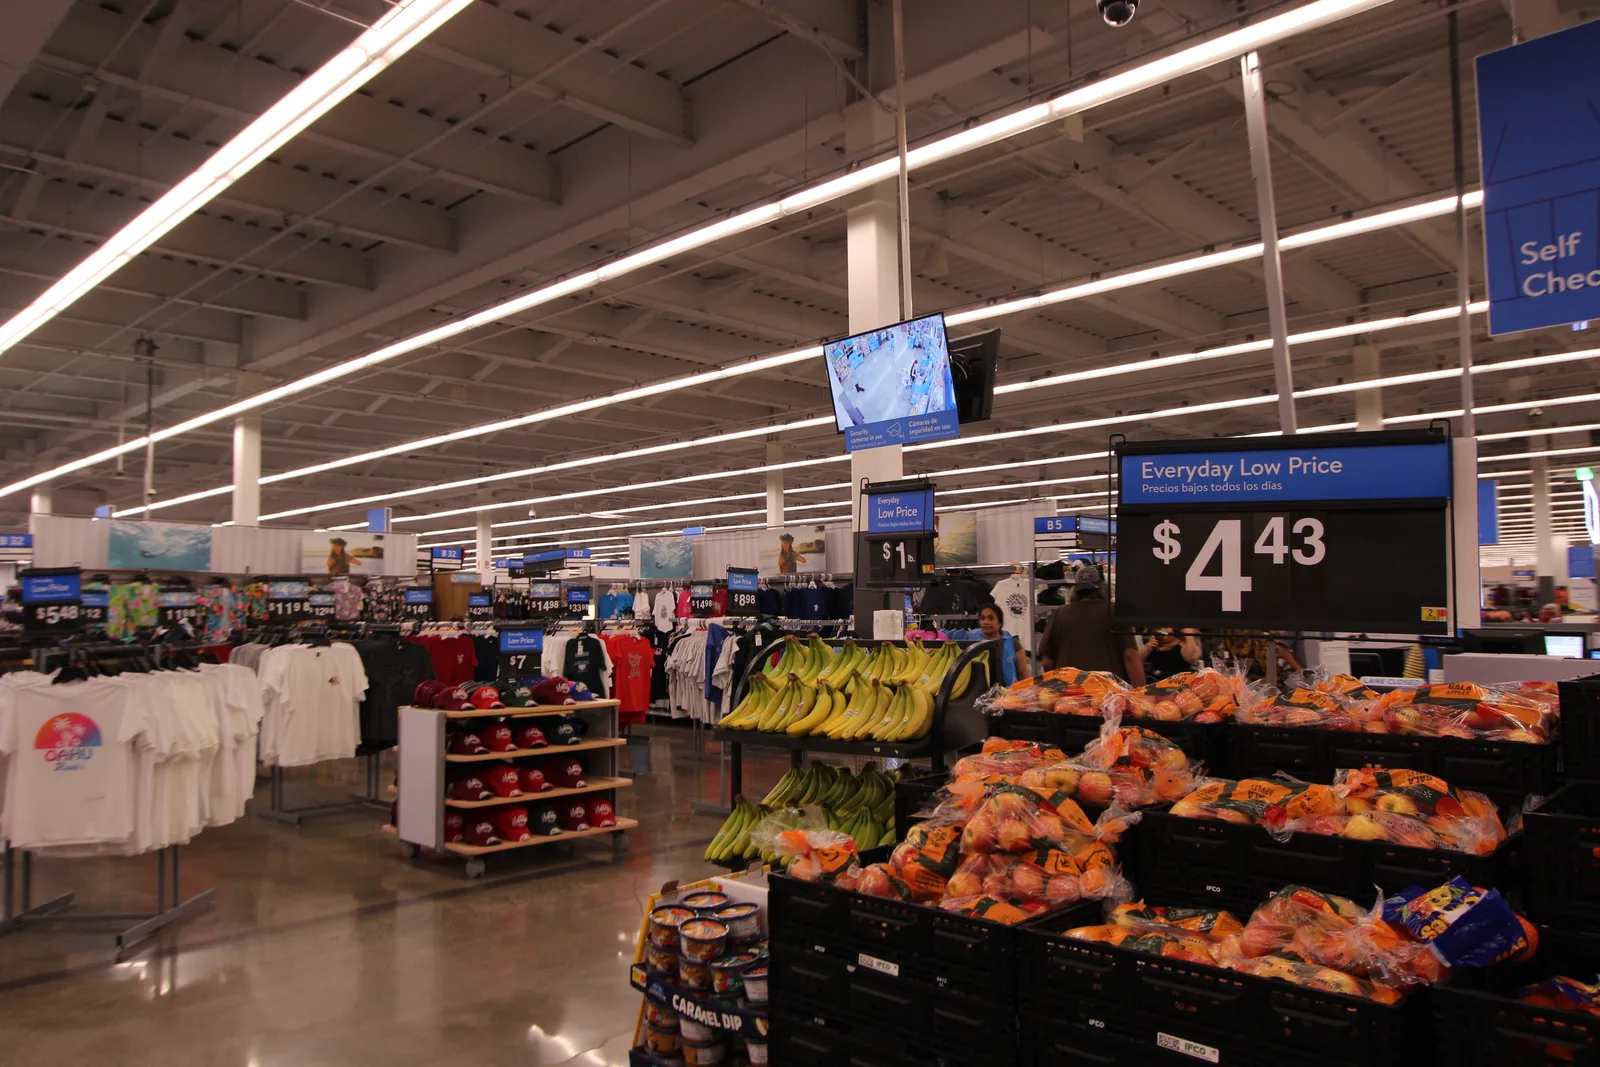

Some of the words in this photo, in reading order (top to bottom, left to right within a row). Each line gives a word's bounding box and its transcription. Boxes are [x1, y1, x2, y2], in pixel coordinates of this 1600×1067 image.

[1520, 231, 1582, 265] Self
[908, 418, 930, 428] Cámaras
[850, 428, 869, 437] Security
[909, 424, 934, 436] seguridad
[850, 435, 870, 444] cameras
[1141, 459, 1234, 483] Everyday
[1240, 457, 1281, 477] Low
[1288, 455, 1343, 475] Price
[1142, 483, 1179, 494] Precios
[1181, 481, 1208, 495] bajos
[1210, 481, 1240, 492] todos
[1243, 480, 1258, 491] los
[1260, 479, 1282, 491] días
[877, 496, 900, 505] Everyday
[878, 507, 895, 519] Low
[896, 505, 918, 517] Price
[507, 637, 520, 645] Low
[520, 636, 535, 644] Price
[1448, 683, 1472, 691] GALA
[672, 993, 721, 1028] CARAMEL
[721, 1013, 742, 1031] DIP
[1184, 1042, 1206, 1055] IFCO
